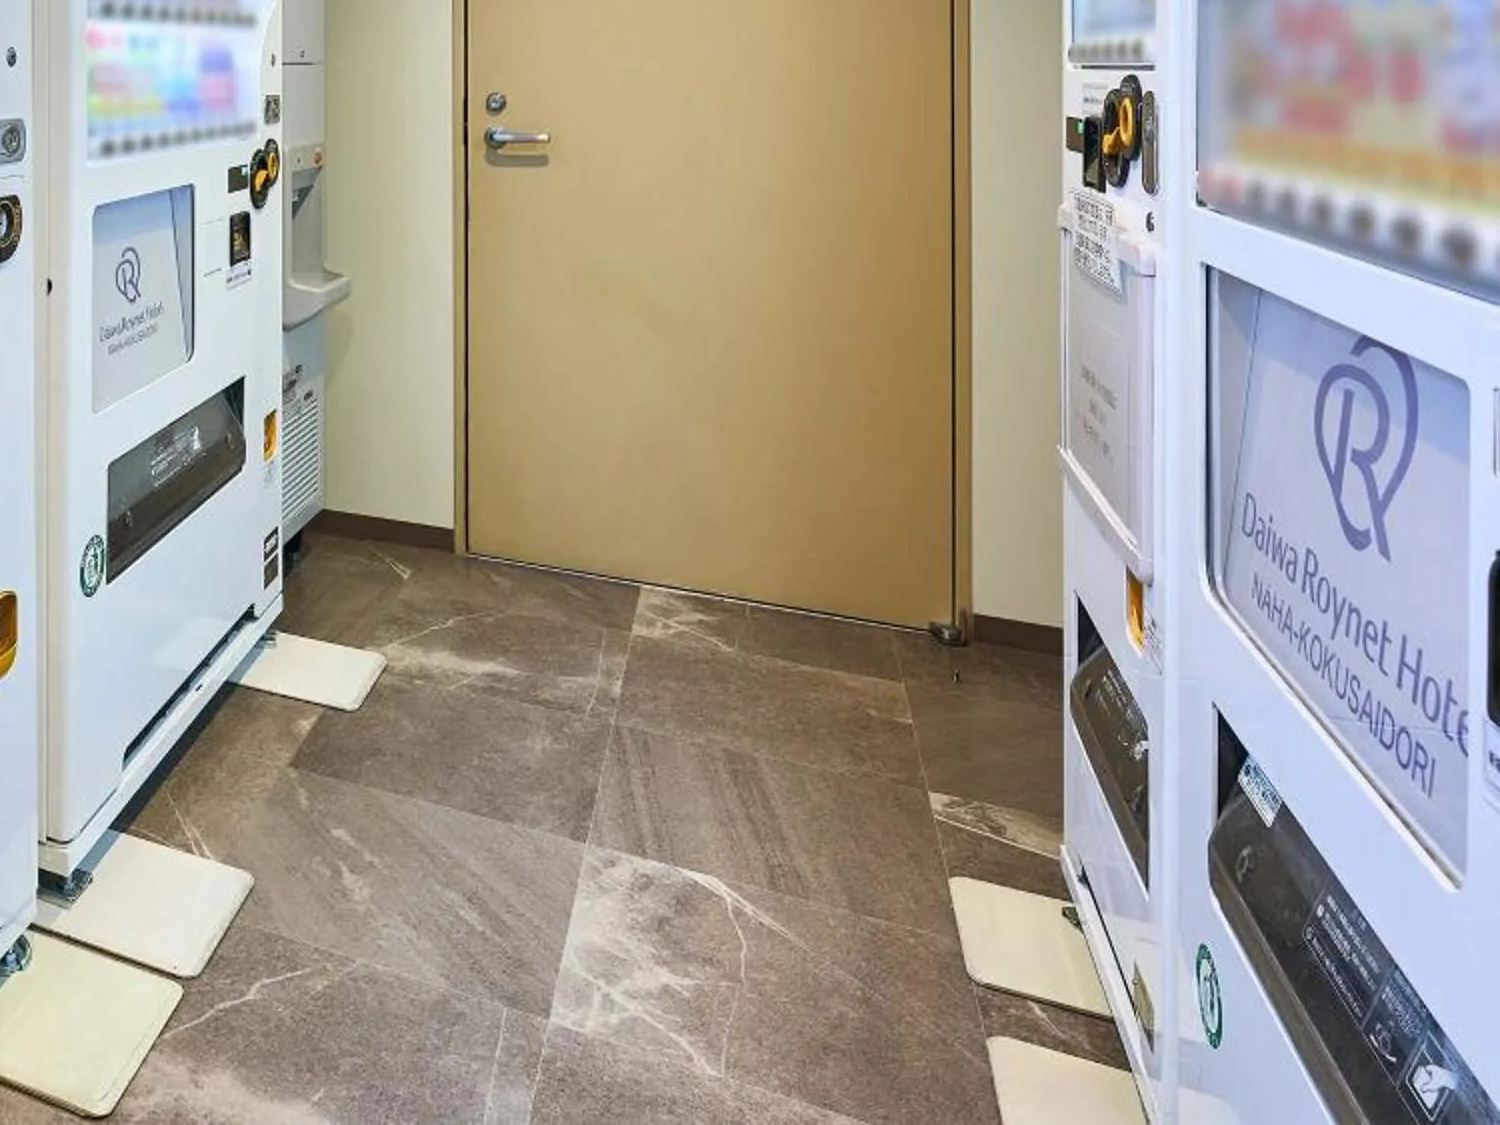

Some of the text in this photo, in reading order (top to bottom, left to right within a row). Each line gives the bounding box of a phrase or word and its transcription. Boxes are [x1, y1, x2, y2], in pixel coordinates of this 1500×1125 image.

[1240, 491, 1299, 583] Daiwa
[1302, 546, 1393, 678] Roynet
[1251, 570, 1436, 798] NAHA-KOKUSAIDORI
